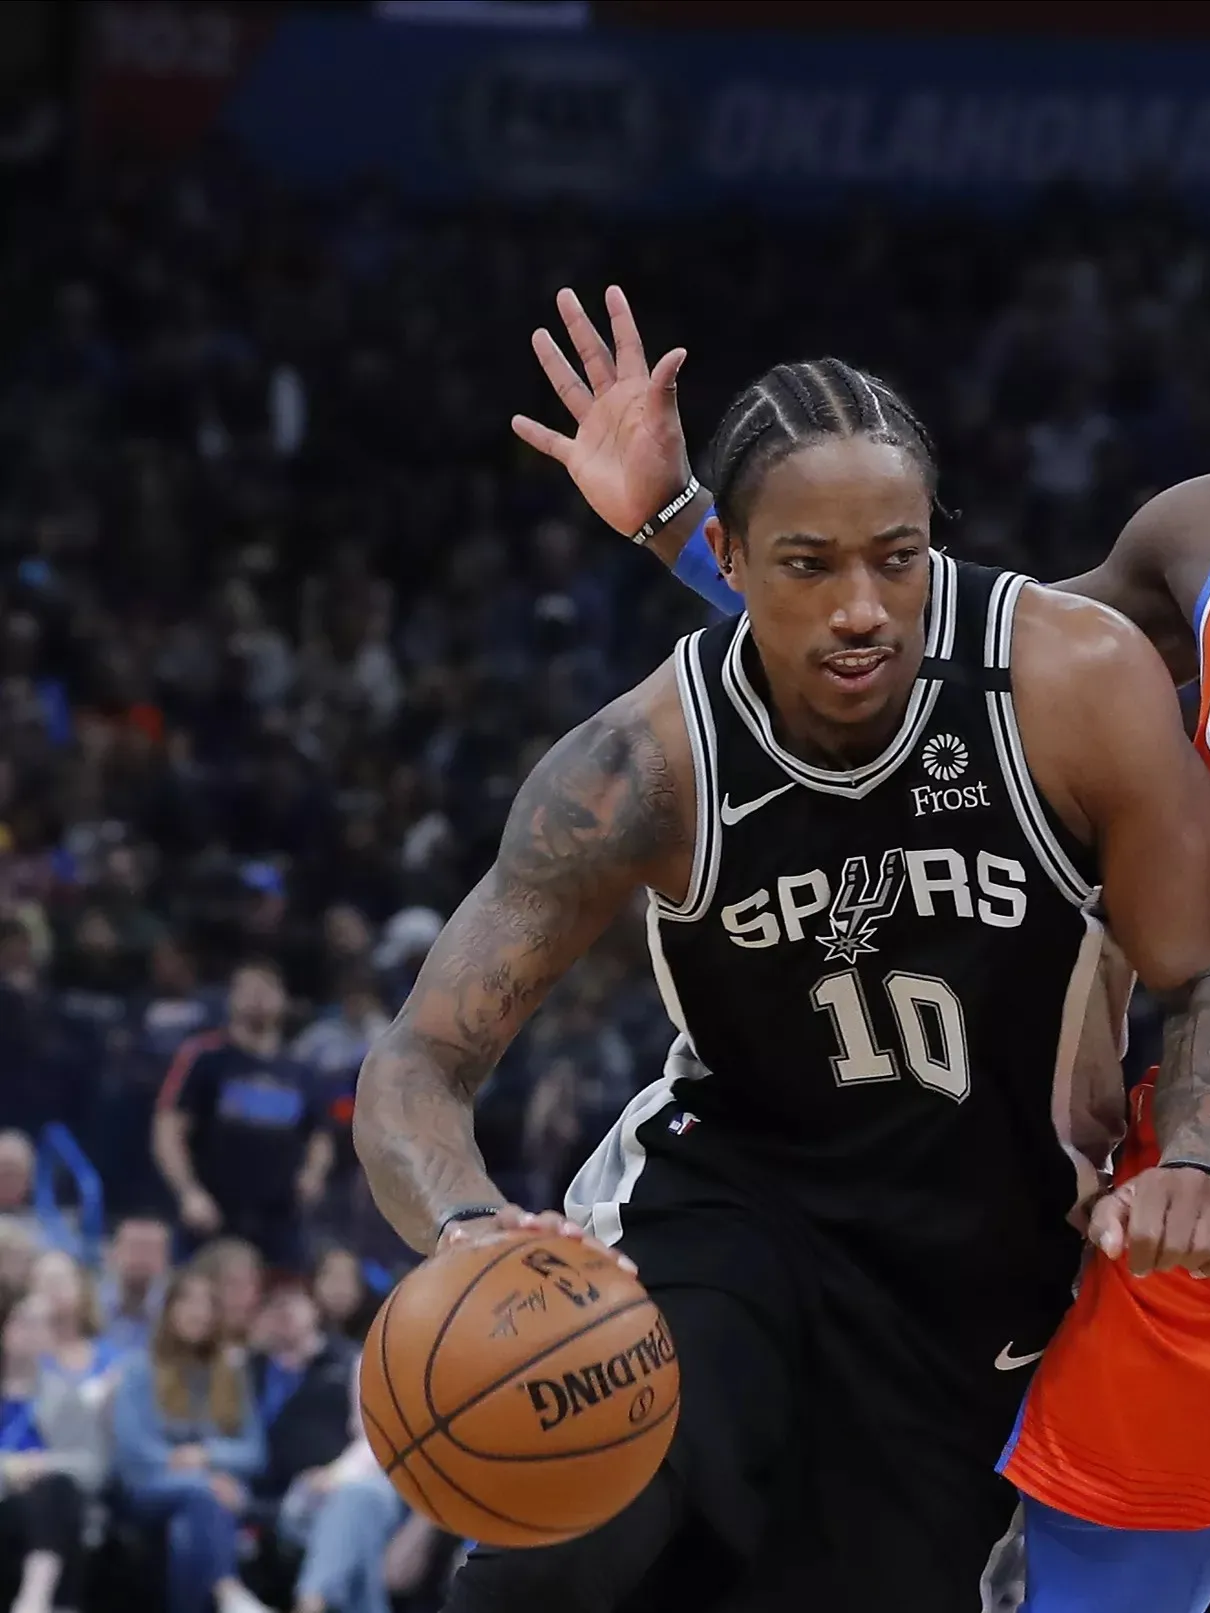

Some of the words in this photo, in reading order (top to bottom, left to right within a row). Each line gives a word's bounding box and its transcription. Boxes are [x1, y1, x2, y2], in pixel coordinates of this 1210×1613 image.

[910, 780, 991, 817] Frost
[721, 848, 1027, 963] SPURS
[810, 968, 971, 1104] 10
[518, 1313, 676, 1432] PALDING
